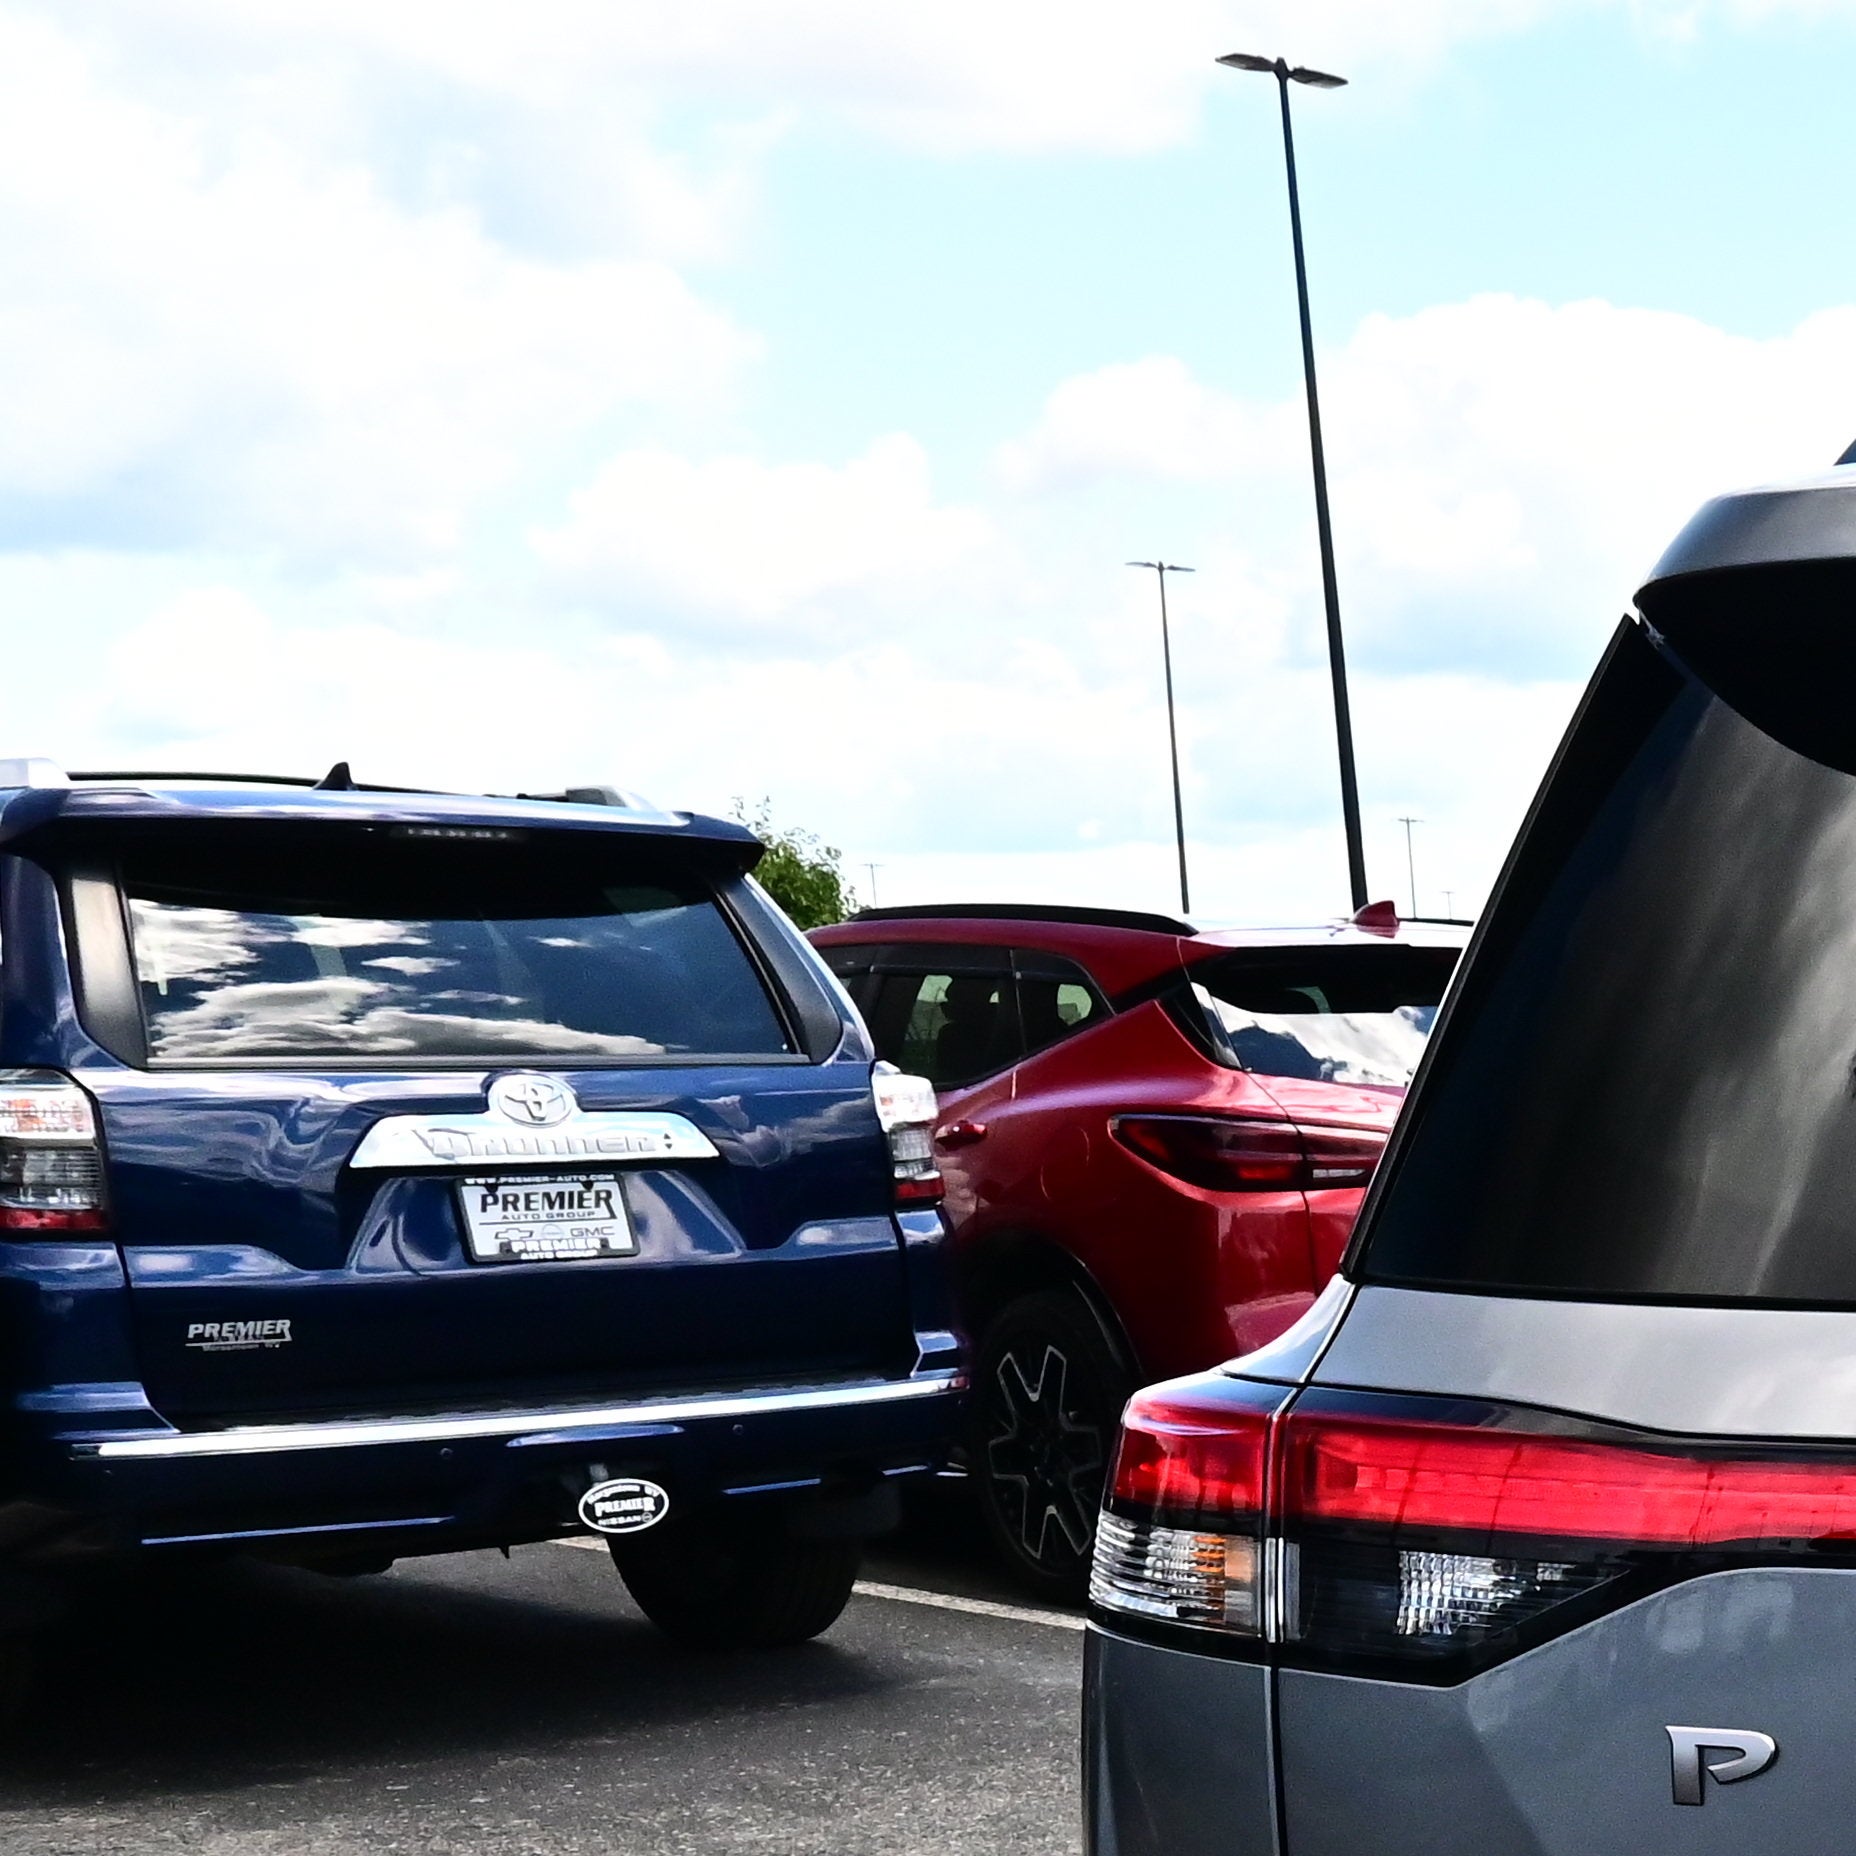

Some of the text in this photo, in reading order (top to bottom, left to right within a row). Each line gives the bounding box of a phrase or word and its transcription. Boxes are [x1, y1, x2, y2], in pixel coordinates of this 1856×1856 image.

[480, 1189, 617, 1219] PREMIER
[502, 1211, 596, 1221] AUTO GROUP
[570, 1226, 615, 1237] GMC
[510, 1238, 601, 1253] PREMIER
[187, 1319, 293, 1341] PREMIER
